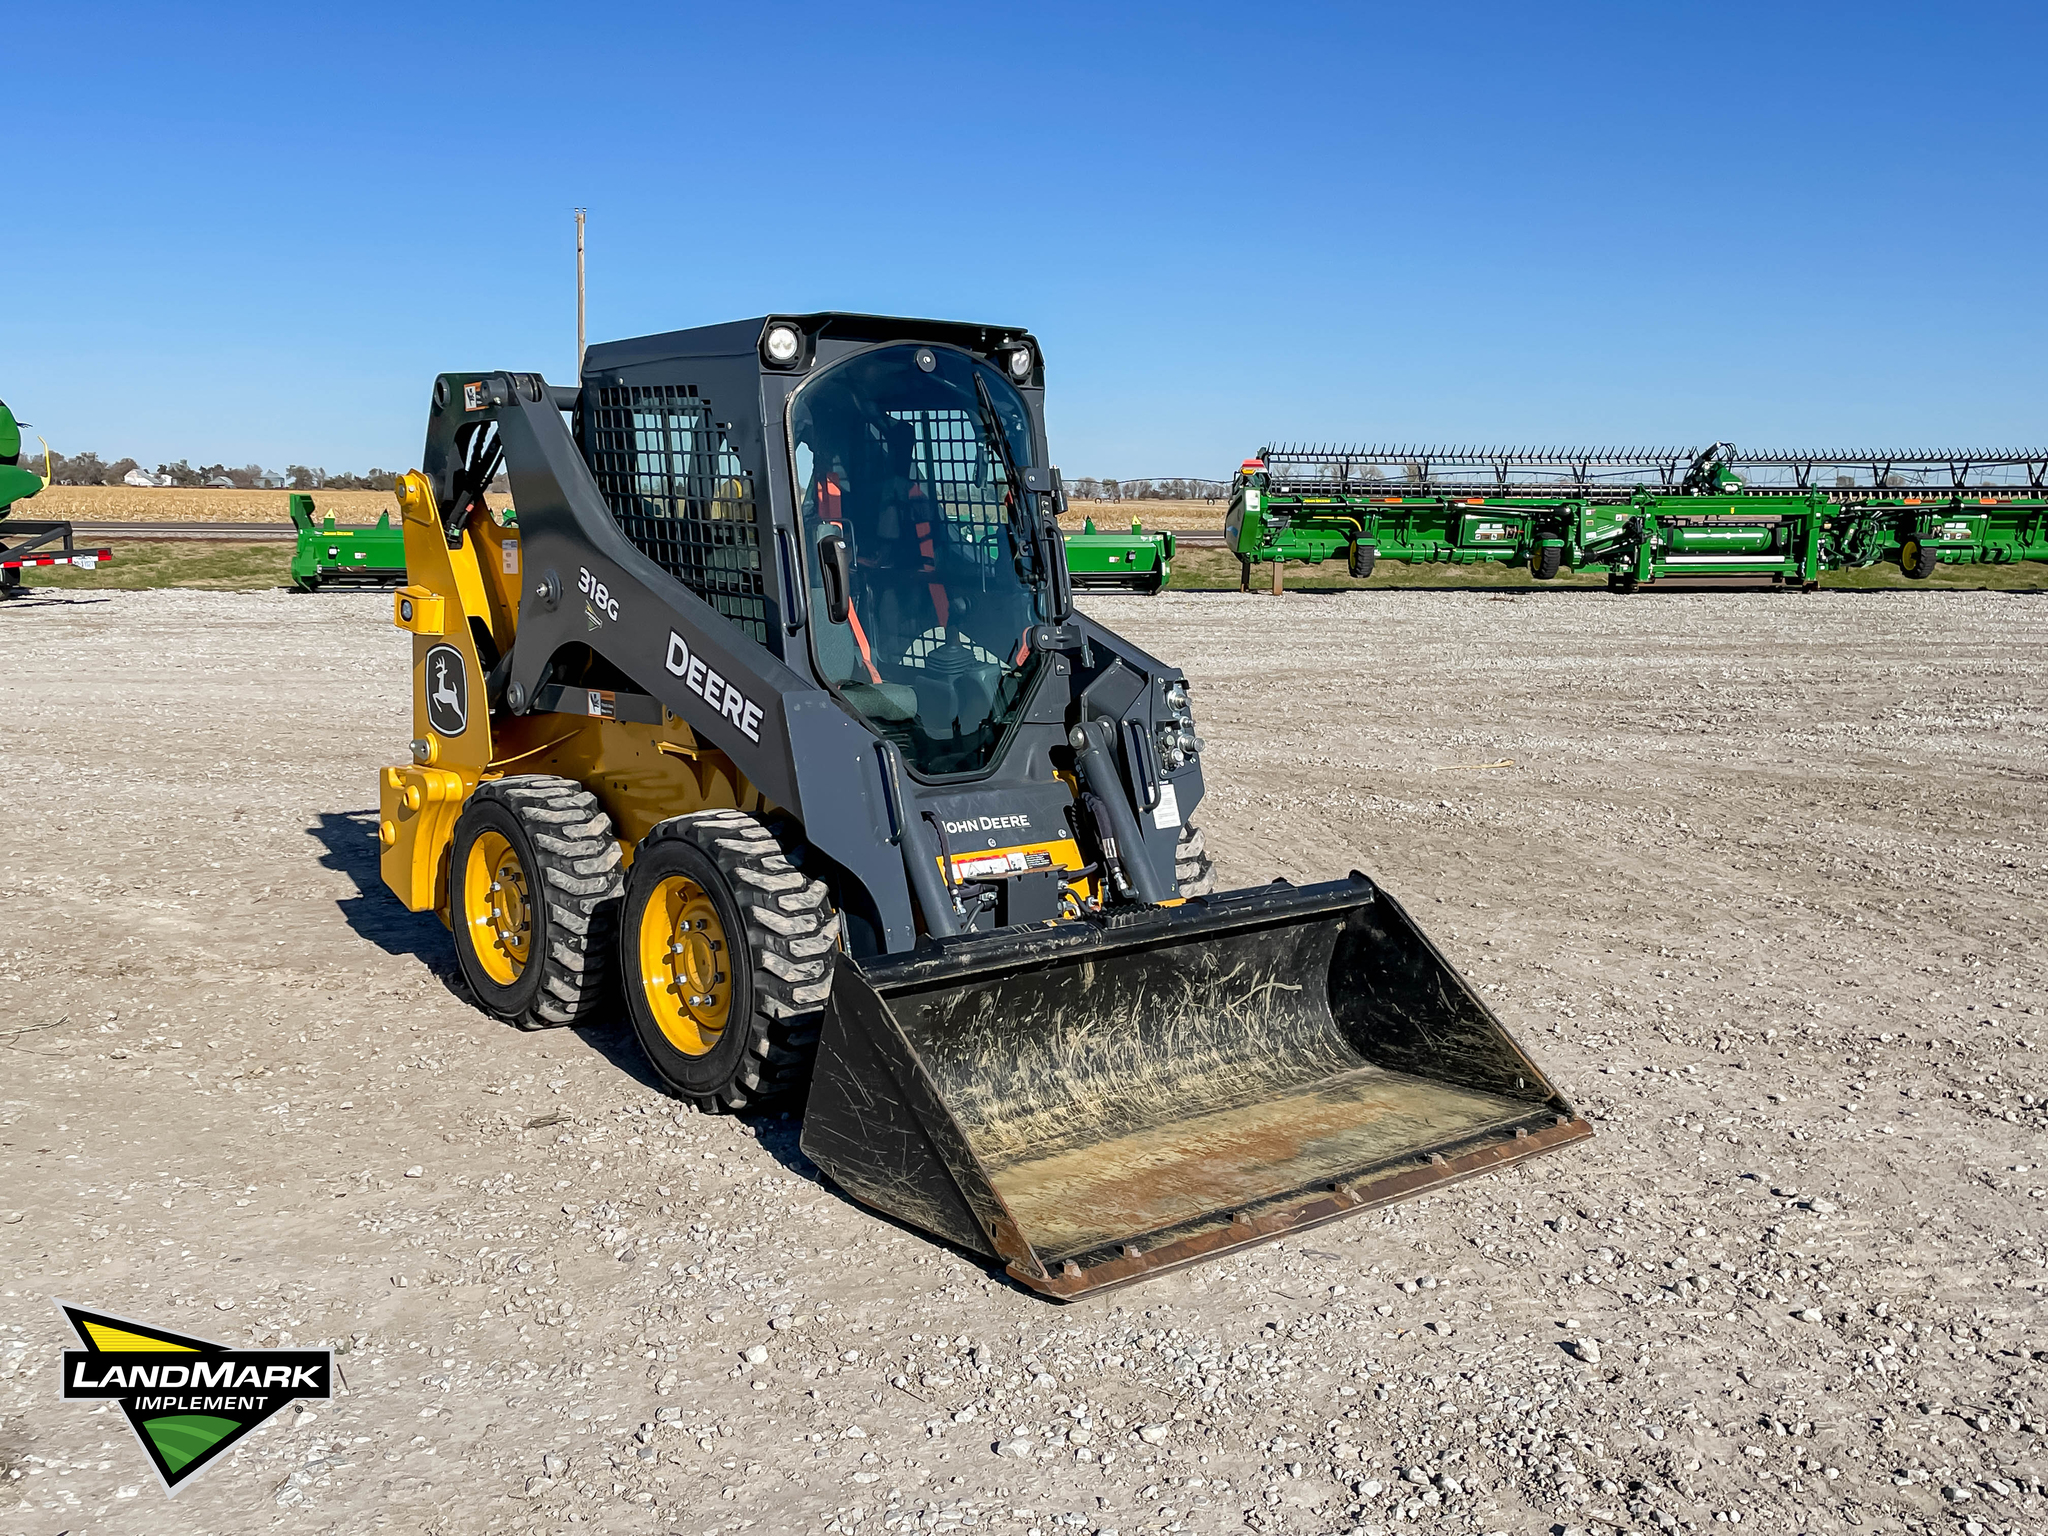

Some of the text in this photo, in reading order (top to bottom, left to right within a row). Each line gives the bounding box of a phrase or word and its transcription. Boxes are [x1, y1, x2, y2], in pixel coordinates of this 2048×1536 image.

[577, 566, 620, 622] 318G
[665, 630, 764, 743] DEERE
[979, 815, 1030, 831] DEERE
